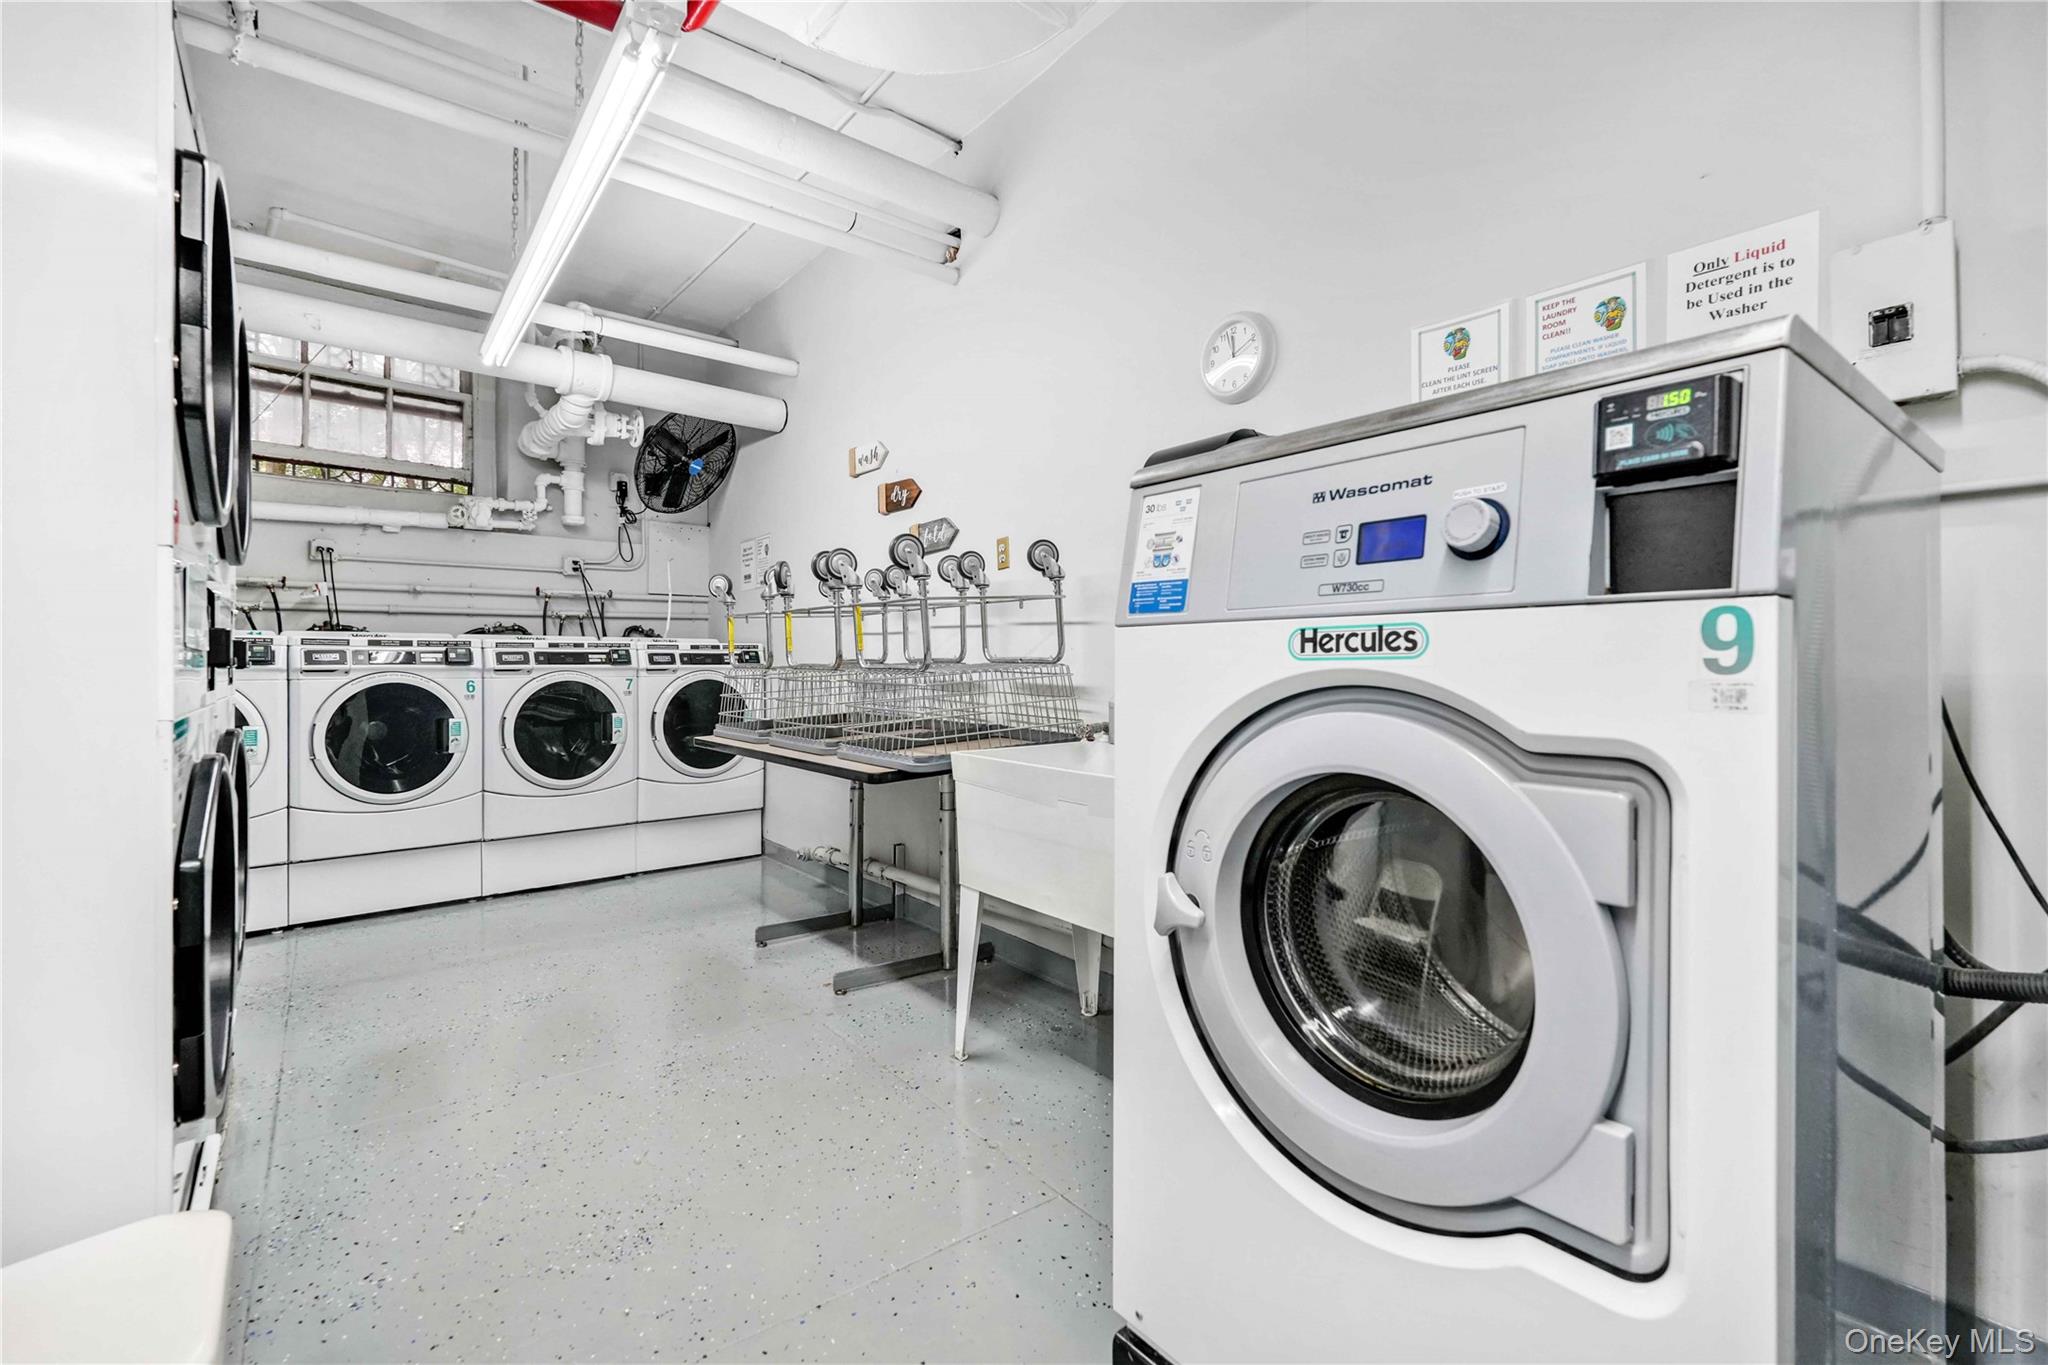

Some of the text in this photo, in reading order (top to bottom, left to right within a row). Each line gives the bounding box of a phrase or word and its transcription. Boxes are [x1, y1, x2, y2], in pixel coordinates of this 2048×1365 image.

[1734, 238, 1786, 263] Liquid
[1685, 256, 1796, 293] Detergent is to
[1686, 276, 1793, 310] be Used in the
[1542, 297, 1576, 311] KEEP THE
[1542, 306, 1577, 321] LAUNDRY
[1709, 300, 1767, 321] Washer
[1542, 319, 1566, 331] ROOM
[1542, 328, 1571, 340] CLEAN!!
[1421, 365, 1498, 388] CLEAN THE LINT SCREEN
[1448, 362, 1470, 372] PLEASE
[1432, 386, 1452, 395] AFTER
[1453, 381, 1470, 390] EACH
[858, 445, 878, 466] wash
[890, 485, 910, 507] dry
[1328, 474, 1433, 502] Wascomat
[1145, 504, 1156, 514] 30
[924, 523, 947, 547] fold
[1331, 583, 1370, 594] W730cc
[1300, 625, 1418, 654] Hercules
[1701, 605, 1754, 675] 9
[466, 680, 476, 693] 6
[625, 678, 633, 690] 7
